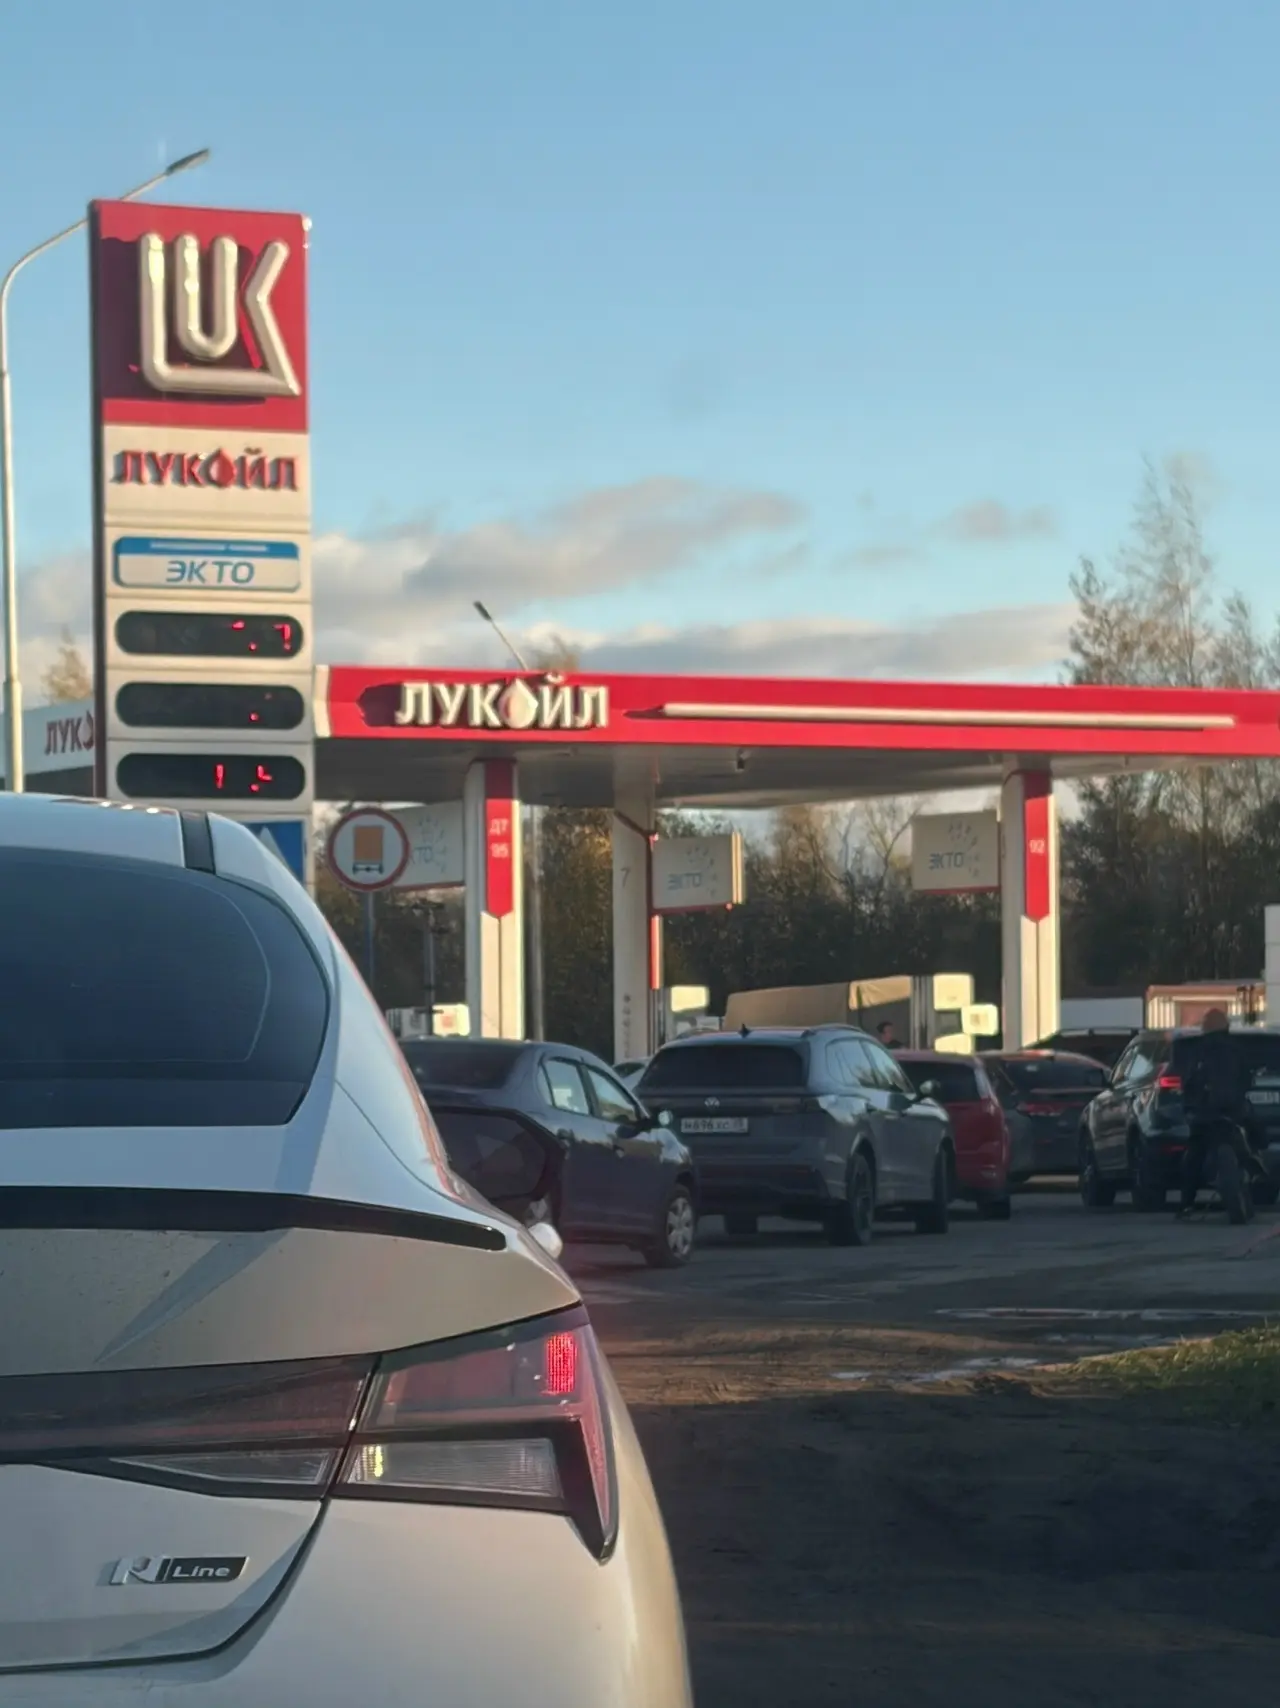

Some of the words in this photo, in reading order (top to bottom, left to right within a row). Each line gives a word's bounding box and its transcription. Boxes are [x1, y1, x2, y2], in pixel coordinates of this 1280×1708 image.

[113, 447, 299, 491] ЛУКОЙЛ
[166, 560, 255, 584] ЭКТО
[395, 671, 609, 729] ЛУКОЙЛ
[172, 1565, 230, 1577] Line
